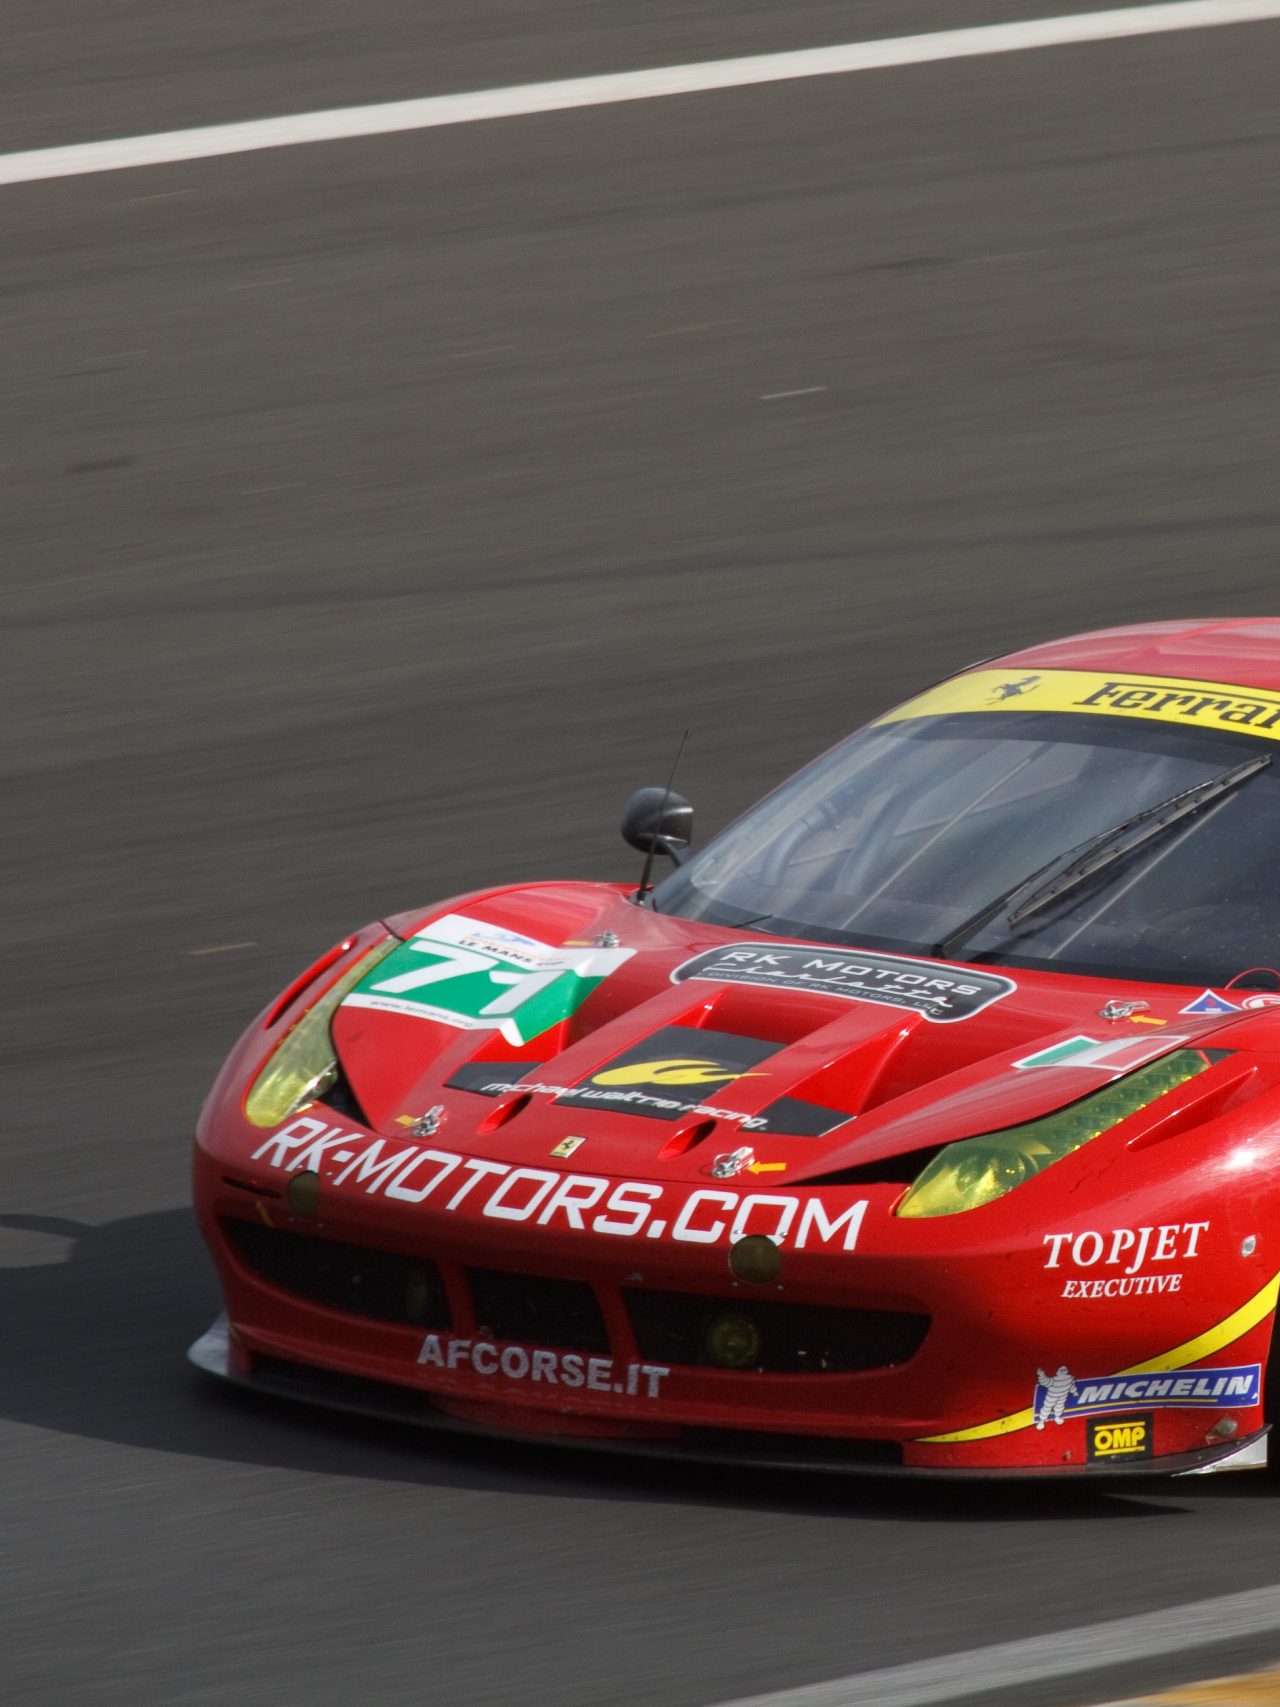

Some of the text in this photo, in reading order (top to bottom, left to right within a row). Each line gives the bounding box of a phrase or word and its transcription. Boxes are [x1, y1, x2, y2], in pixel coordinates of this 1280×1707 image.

[369, 940, 568, 1016] 71
[719, 951, 982, 996] RK MOTORS
[682, 1104, 768, 1130] racing
[252, 1116, 869, 1251] RK-MOTORS.COM
[1042, 1221, 1210, 1274] TOPJET
[1060, 1273, 1183, 1299] EXECUTIVE
[417, 1333, 670, 1400] AFCORSE.IT
[1076, 1373, 1255, 1406] MICHELIN
[1094, 1427, 1146, 1450] OMP
